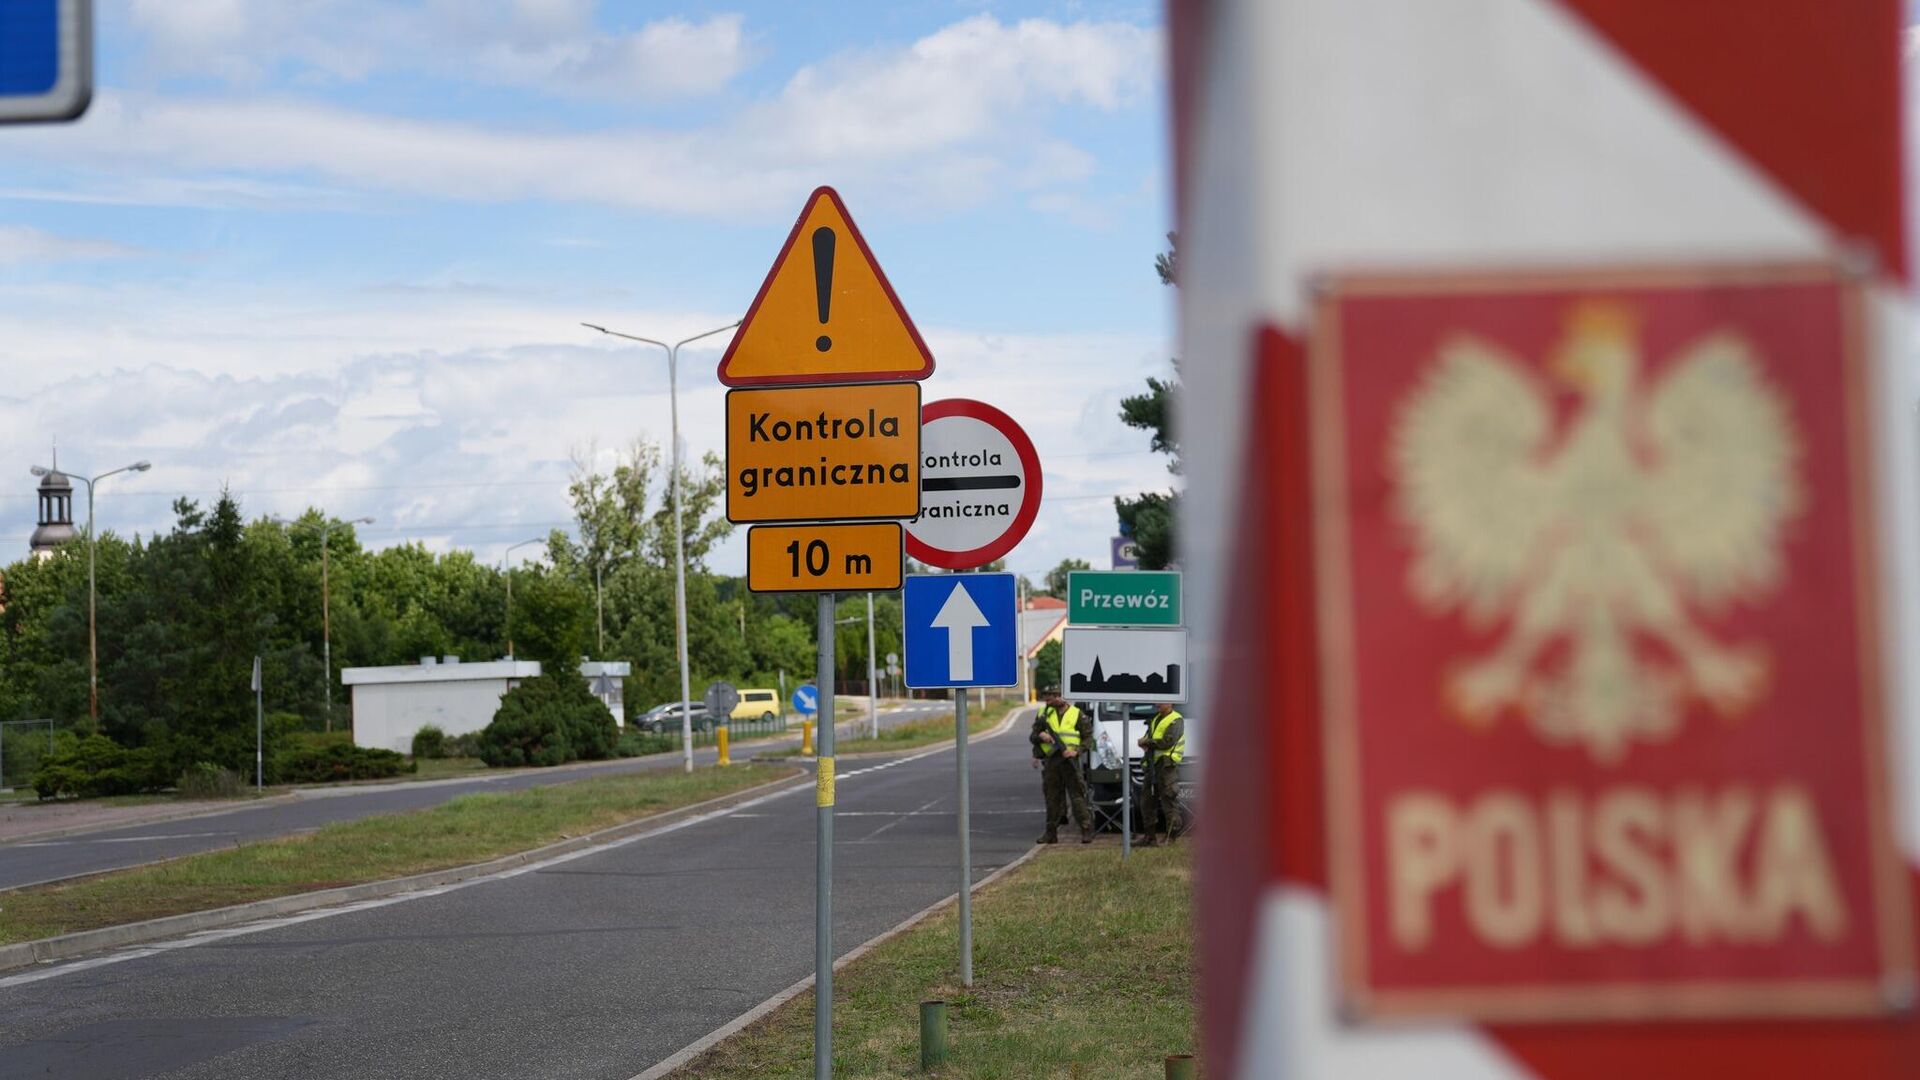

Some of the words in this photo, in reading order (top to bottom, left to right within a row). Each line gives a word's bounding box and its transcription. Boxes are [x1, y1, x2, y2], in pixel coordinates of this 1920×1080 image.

[750, 409, 899, 442] Kontrola
[921, 449, 1002, 469] ontrola
[739, 457, 910, 497] graniczna
[787, 539, 830, 577] 10
[845, 552, 872, 575] m
[1081, 589, 1169, 608] Przewóz
[1385, 787, 1849, 951] POLSKA
